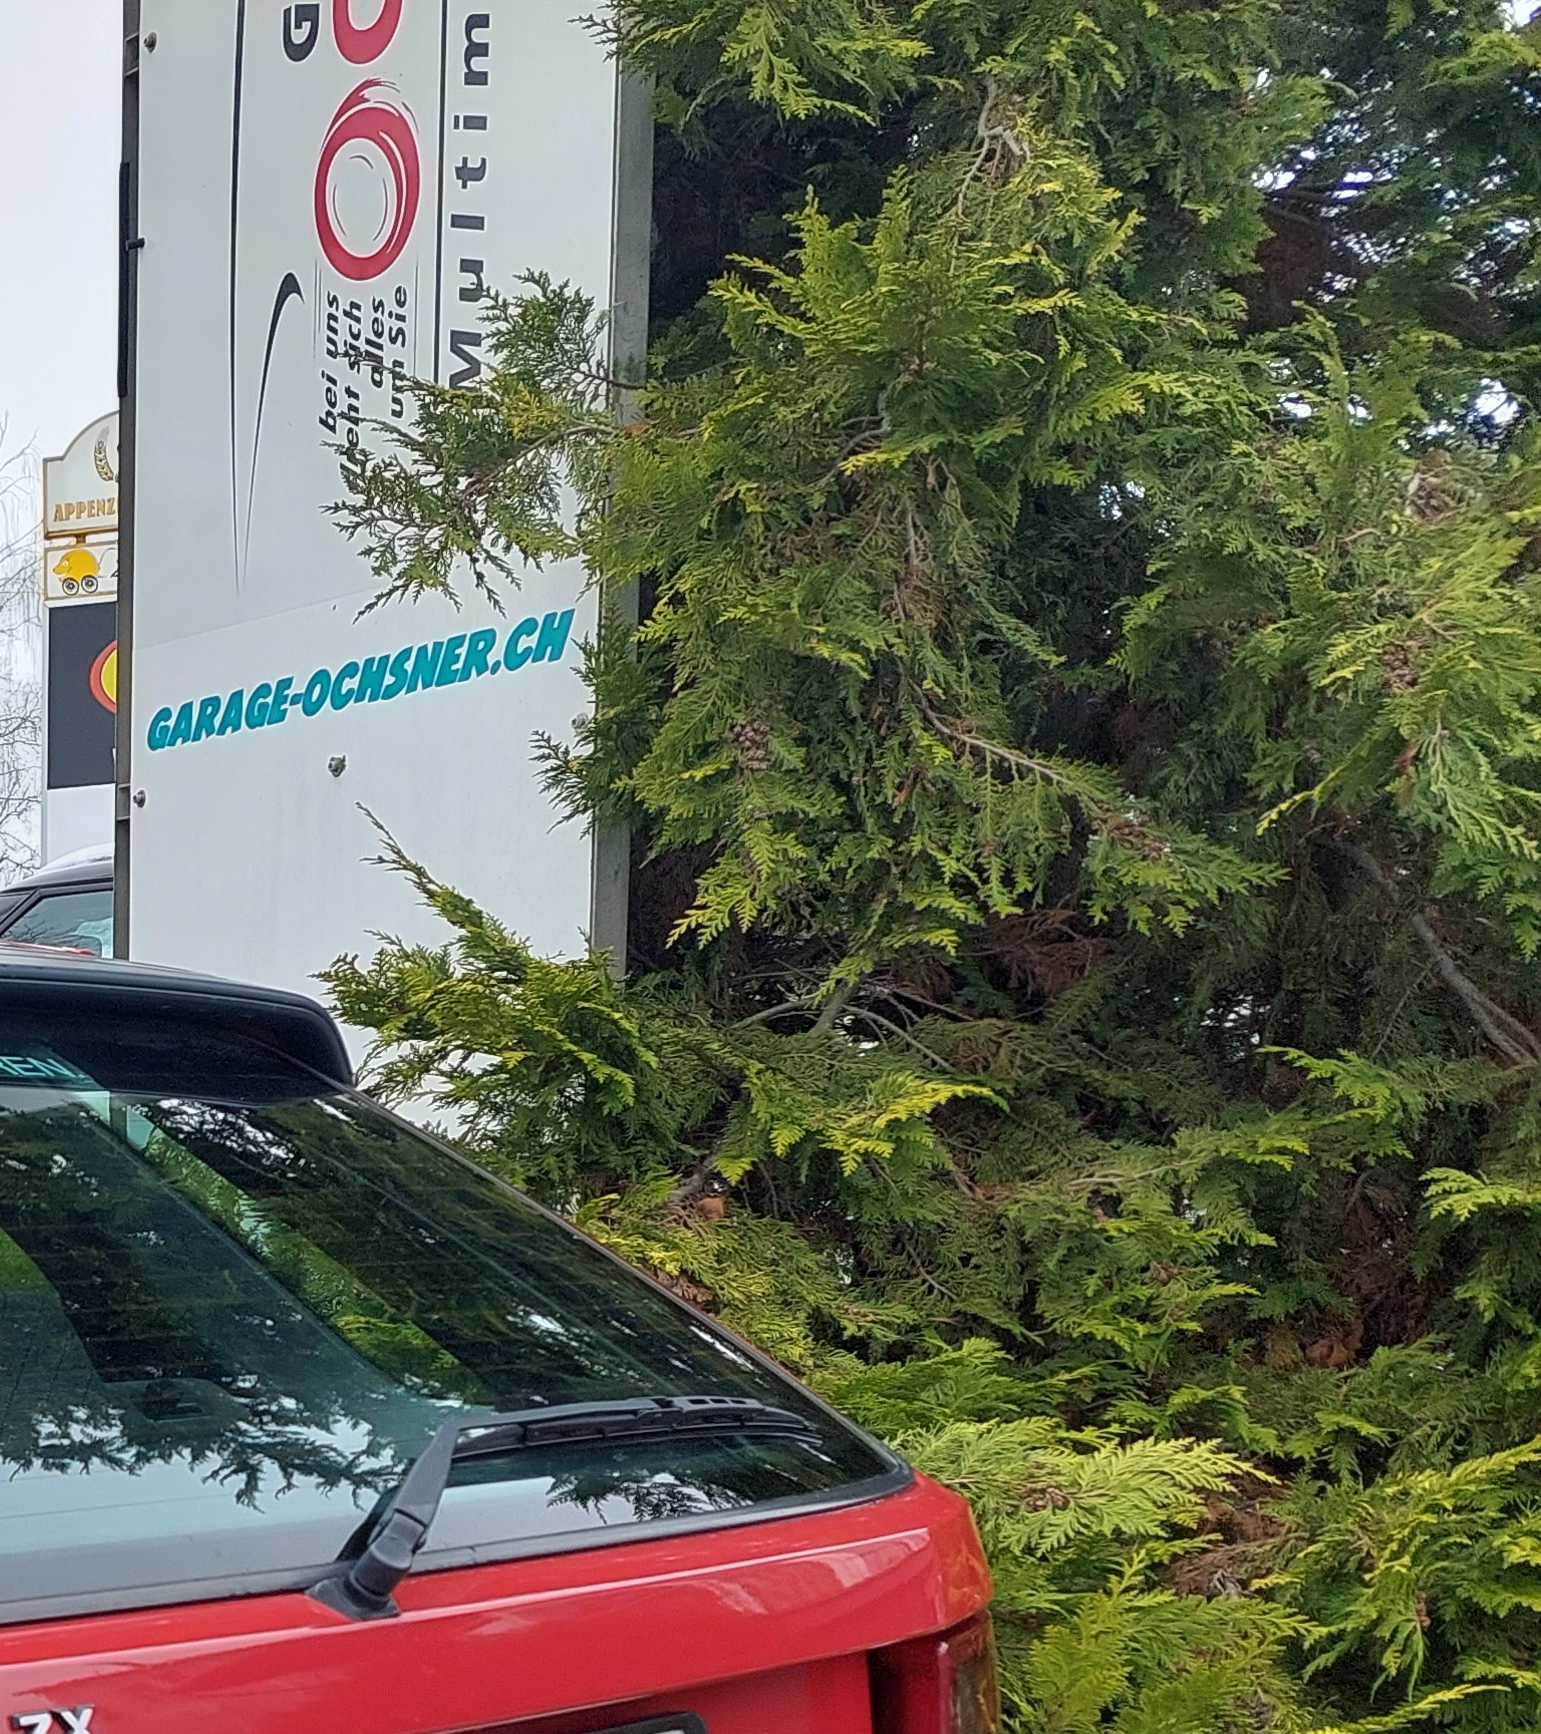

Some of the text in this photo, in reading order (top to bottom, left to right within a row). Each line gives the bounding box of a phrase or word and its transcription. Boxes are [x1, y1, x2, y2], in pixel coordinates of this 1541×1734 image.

[318, 291, 339, 435] bei uns
[387, 285, 407, 348] Sie
[146, 608, 576, 751] GARAGE-OCHSNER.CH
